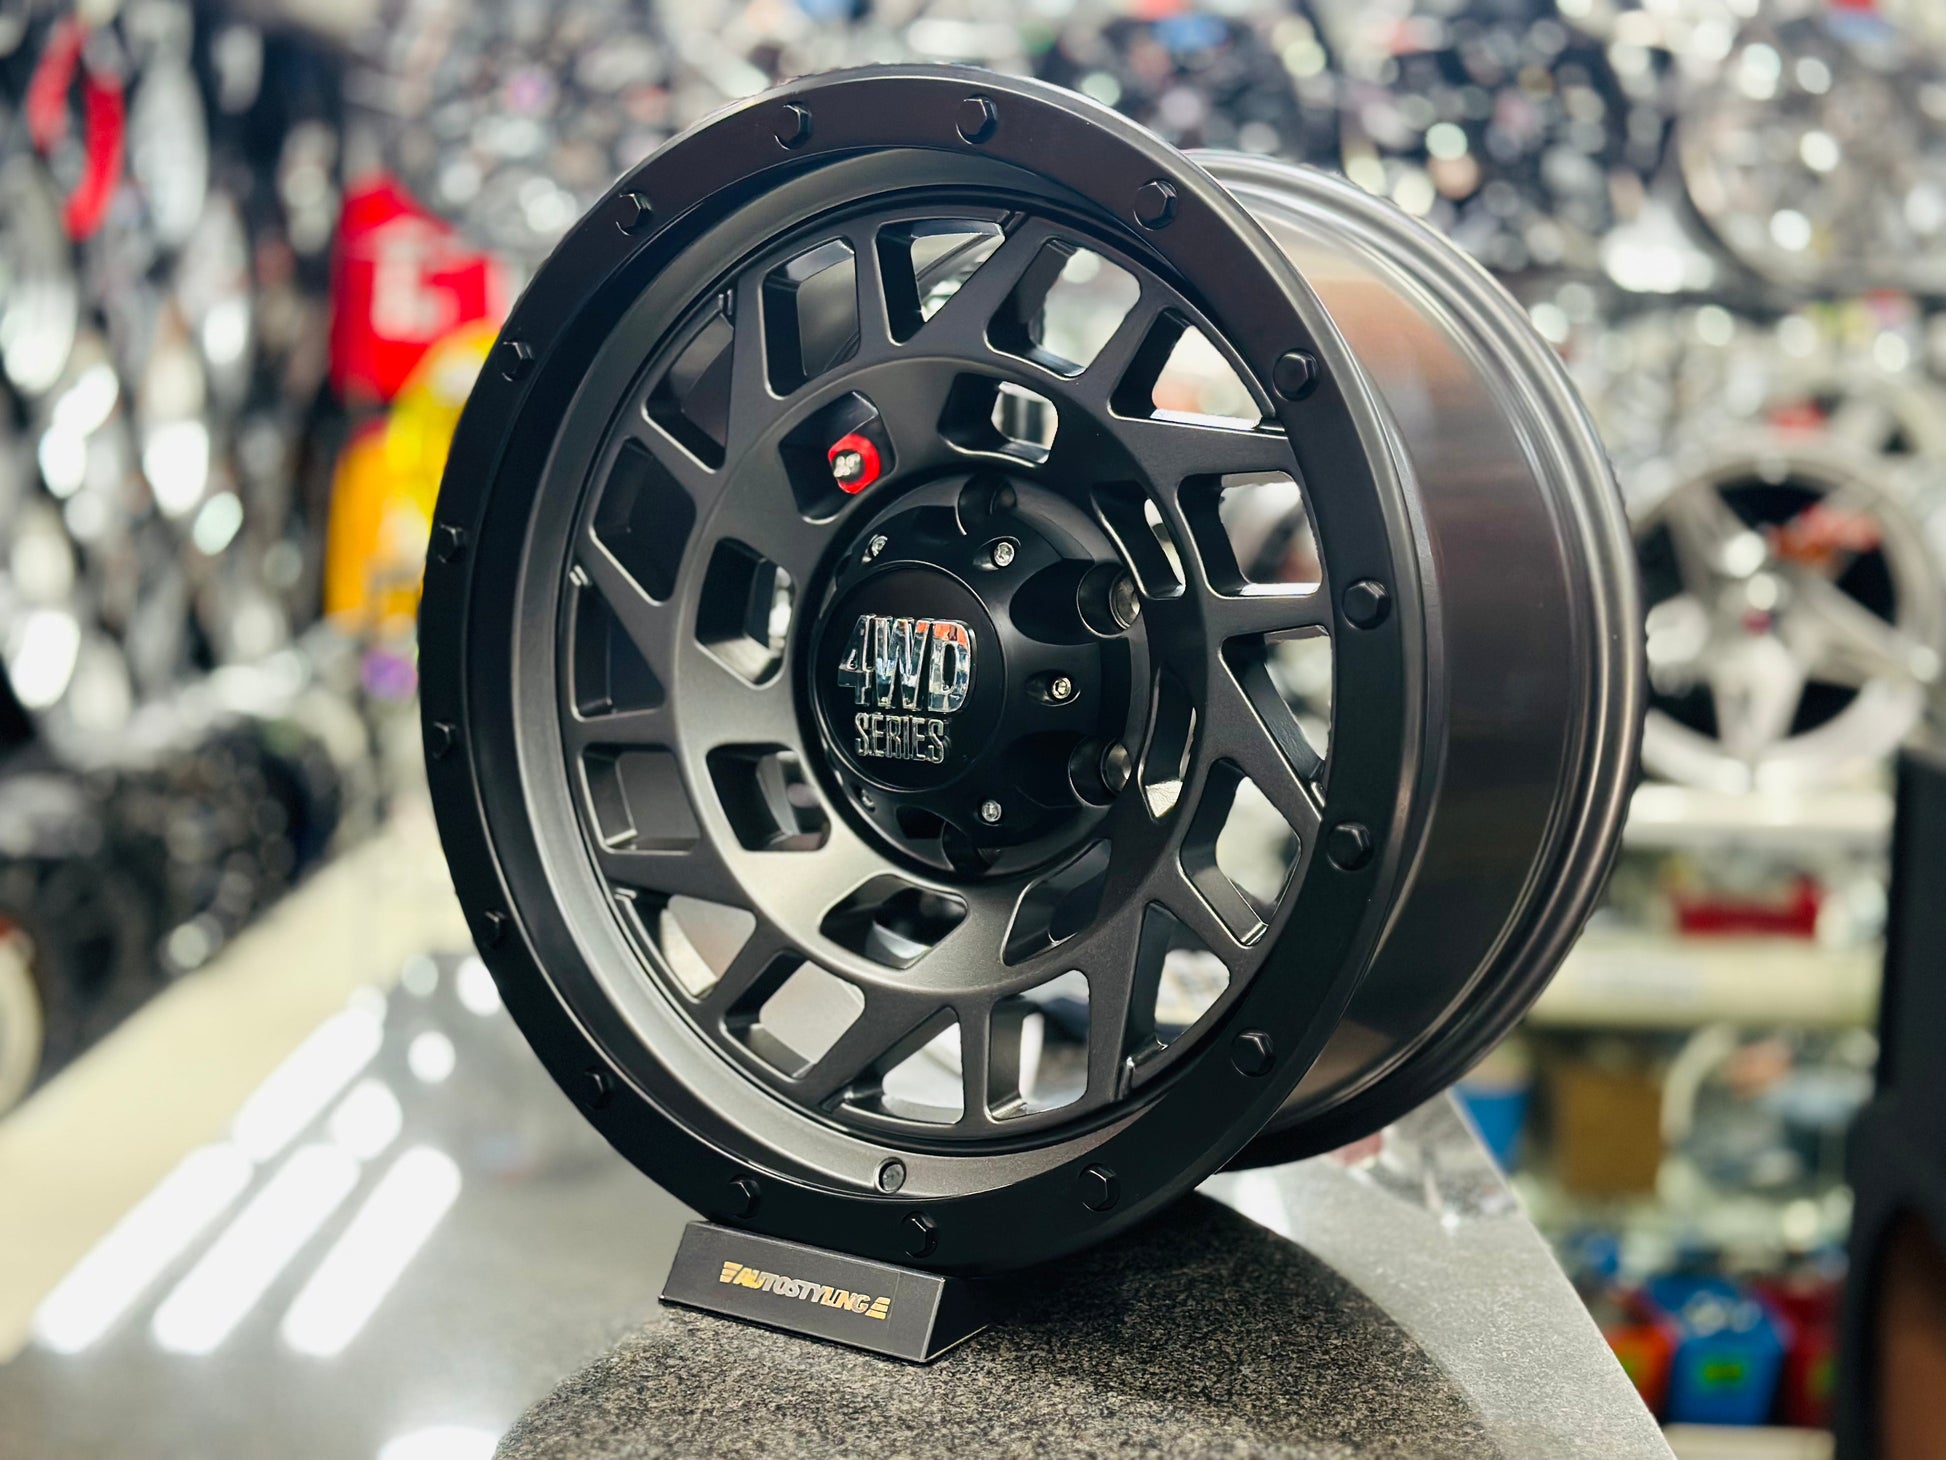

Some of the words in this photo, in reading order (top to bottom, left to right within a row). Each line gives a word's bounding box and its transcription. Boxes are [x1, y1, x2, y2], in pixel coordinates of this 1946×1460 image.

[838, 614, 975, 714] 4WD
[855, 712, 948, 764] SERIES
[732, 1266, 871, 1314] AUTOSTYLING
